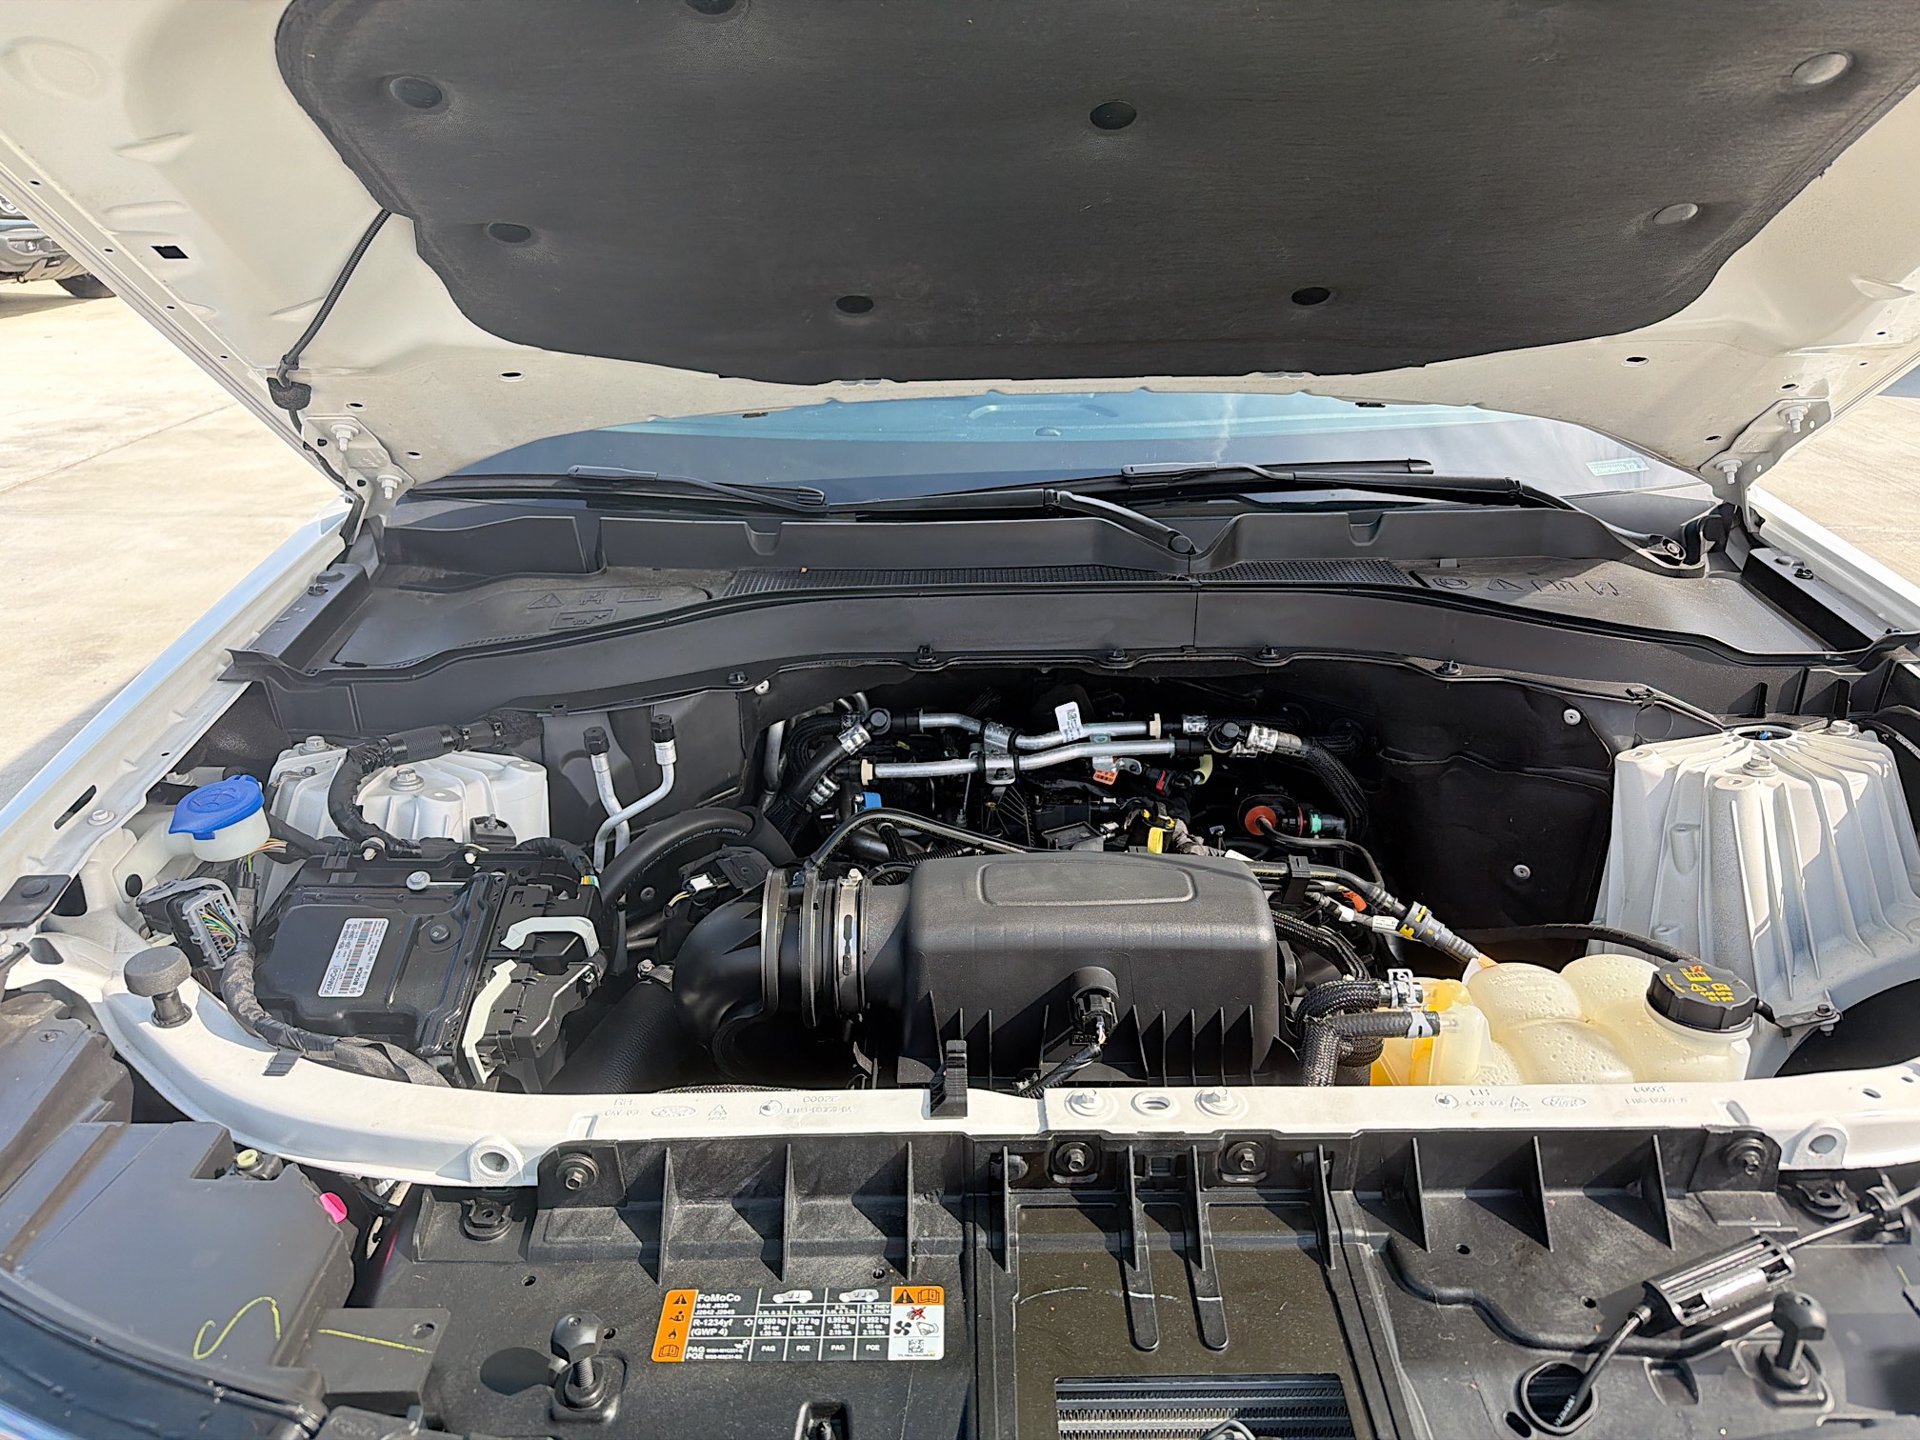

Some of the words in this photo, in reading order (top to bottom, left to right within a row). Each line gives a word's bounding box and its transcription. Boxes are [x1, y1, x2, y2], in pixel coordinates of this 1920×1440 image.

[352, 966, 364, 986] BOSCH
[698, 1293, 741, 1302] FoMoCo
[692, 1319, 734, 1327] R-1234yf
[777, 1318, 787, 1326] kg
[810, 1317, 820, 1326] kg
[846, 1317, 856, 1325] kg
[880, 1316, 889, 1325] kg
[691, 1328, 717, 1336] (GWP
[718, 1328, 728, 1336] 4)
